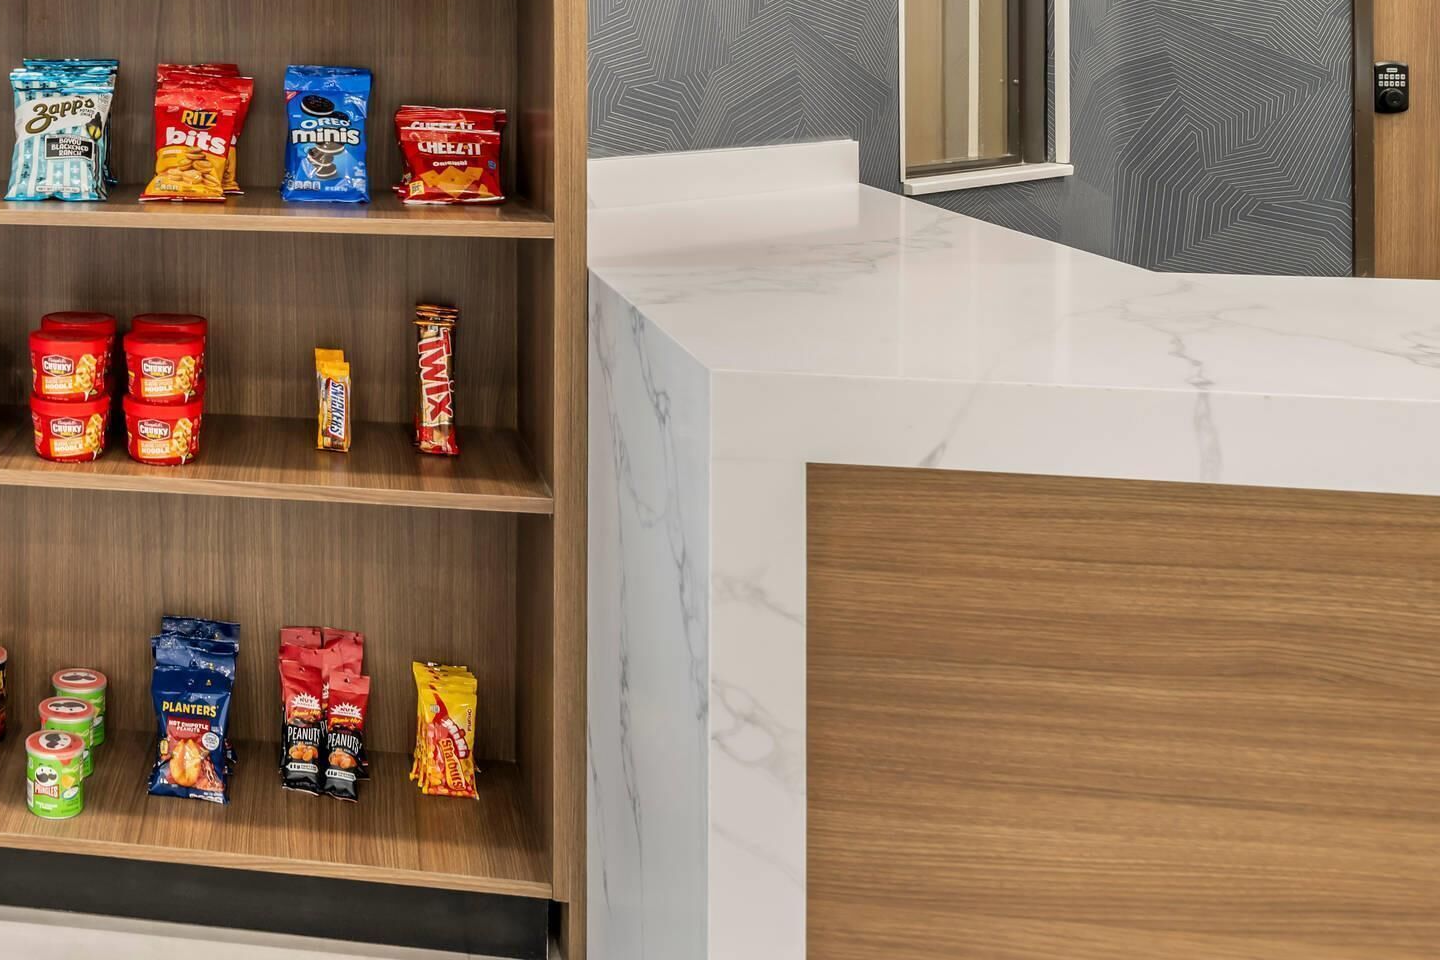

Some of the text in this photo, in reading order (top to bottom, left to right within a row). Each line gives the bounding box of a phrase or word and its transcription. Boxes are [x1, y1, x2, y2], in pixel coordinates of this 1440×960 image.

[181, 109, 218, 127] RITZ
[301, 118, 350, 129] OREO
[166, 126, 227, 156] bits
[292, 128, 360, 145] minis
[330, 380, 345, 436] SNICKERS
[162, 701, 217, 718] PLANTERS
[327, 733, 360, 754] PEANUTS
